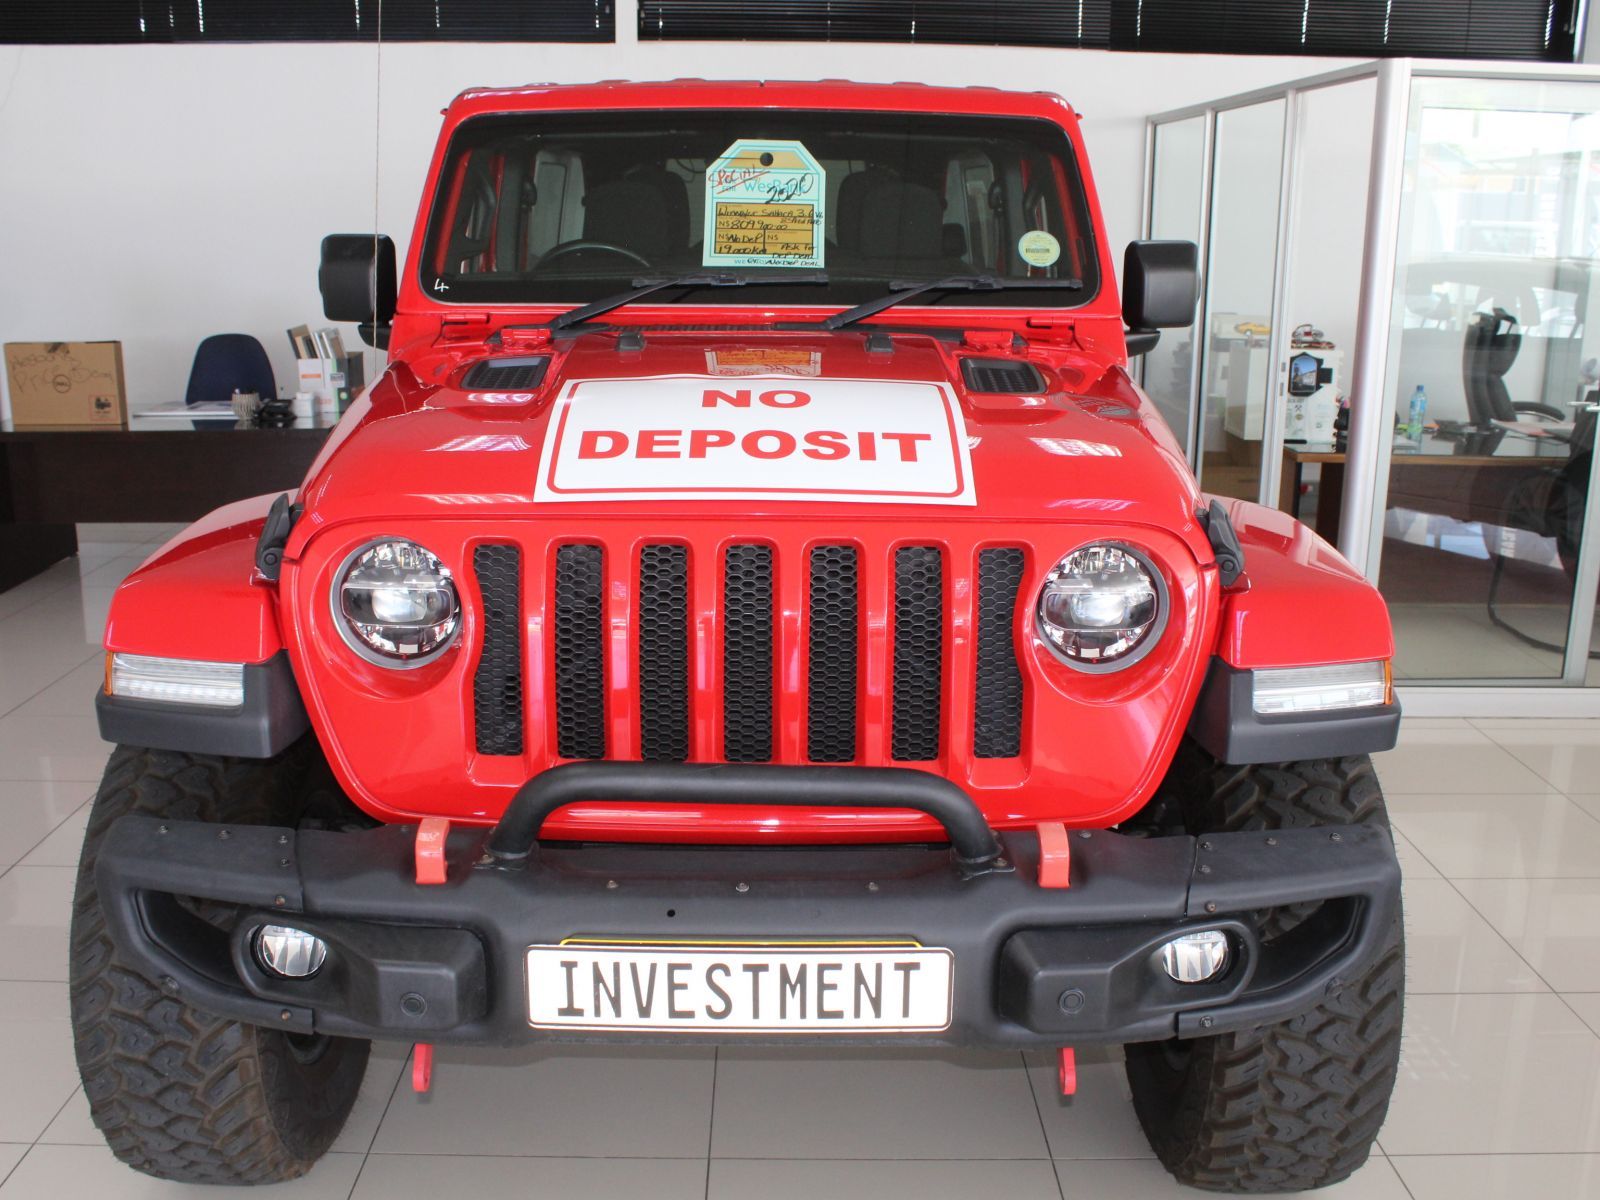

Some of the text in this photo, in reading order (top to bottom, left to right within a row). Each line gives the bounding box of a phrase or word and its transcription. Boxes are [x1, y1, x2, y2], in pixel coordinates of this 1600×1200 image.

[765, 173, 814, 204] 2020
[434, 278, 450, 293] 4
[702, 389, 811, 409] NO
[578, 429, 932, 462] DEPOSIT
[557, 960, 921, 1020] INVESTMENT
